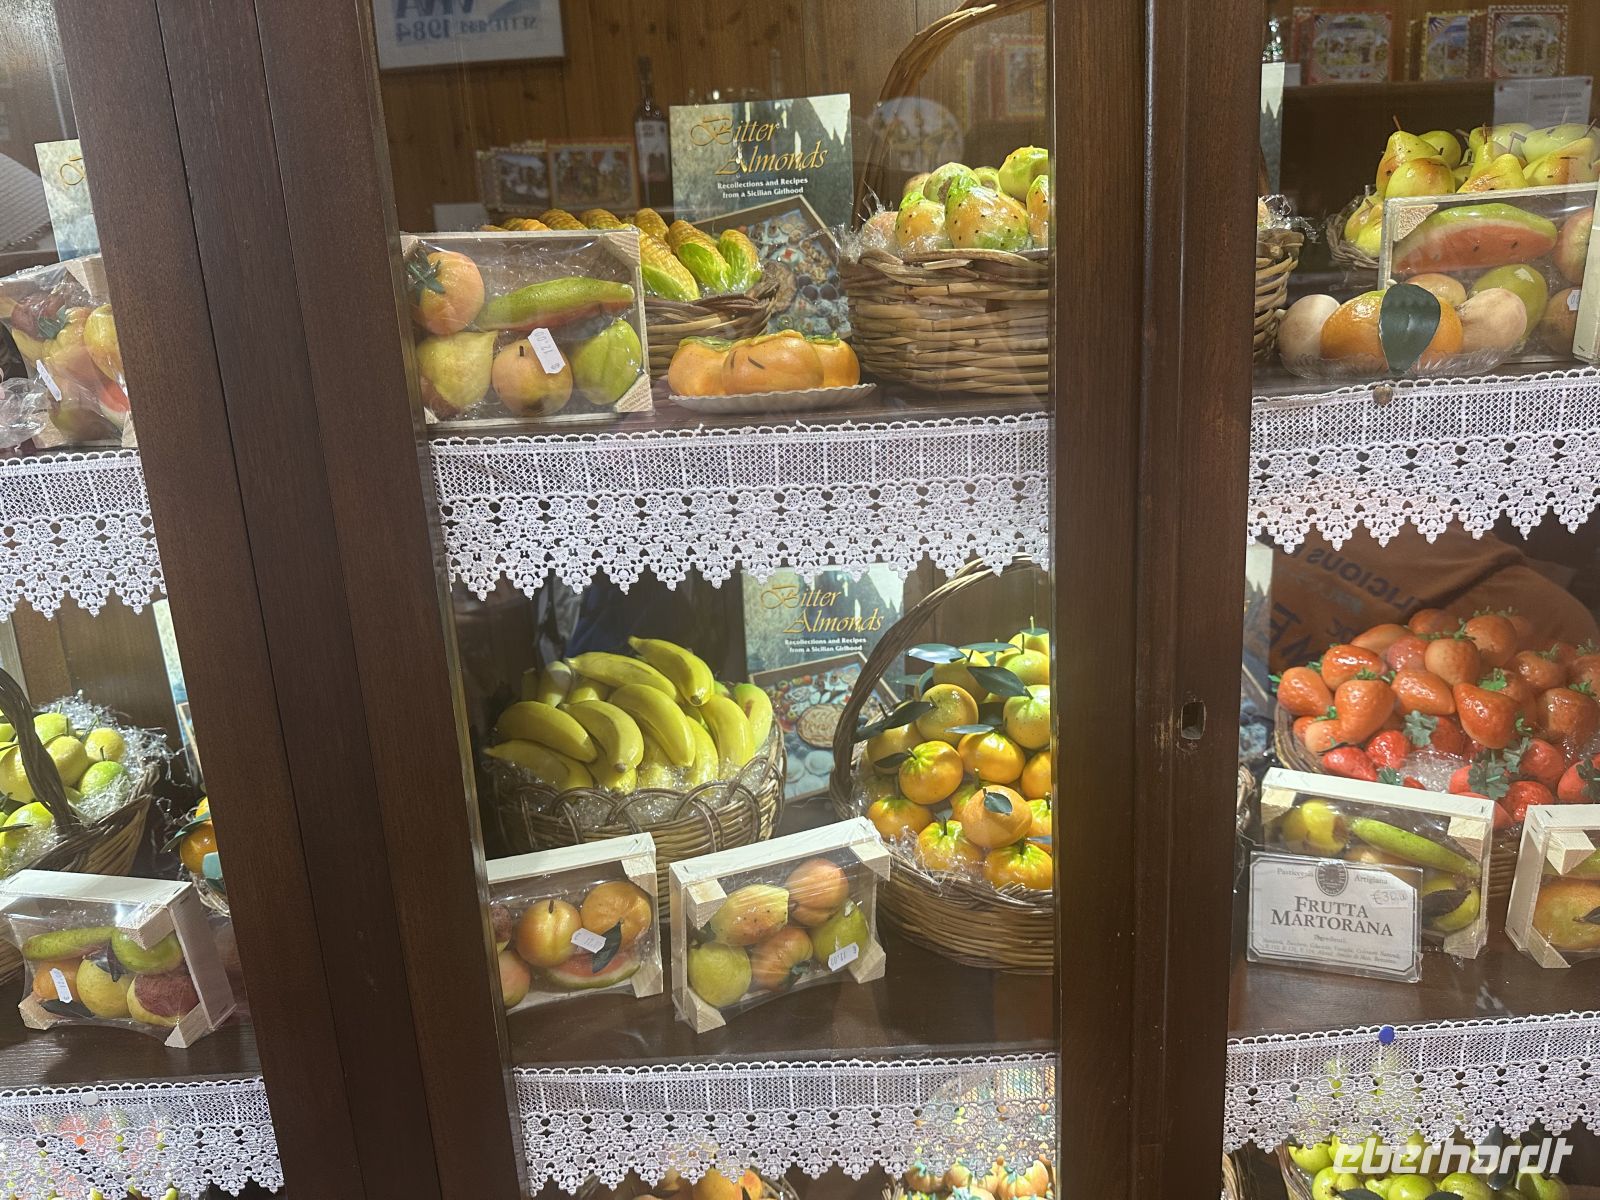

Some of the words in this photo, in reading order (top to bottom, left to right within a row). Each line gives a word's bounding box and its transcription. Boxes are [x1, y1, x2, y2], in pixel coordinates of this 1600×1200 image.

[690, 114, 777, 146] Bitter
[714, 139, 829, 175] Almonds
[718, 180, 764, 190] Recollections
[765, 178, 779, 187] and
[780, 177, 809, 186] Recipes
[722, 190, 739, 199] from
[747, 188, 773, 198] Sicilian
[773, 186, 804, 196] Girlhood
[760, 584, 842, 609] Bitter
[782, 607, 884, 634] Almonds
[784, 638, 827, 646] Recollections
[828, 637, 840, 645] and
[841, 636, 867, 645] Recipes
[811, 645, 834, 653] Sicilian
[835, 644, 863, 652] Girlhood
[1294, 895, 1369, 919] FRUTTA
[1270, 909, 1394, 937] MARTORANA
